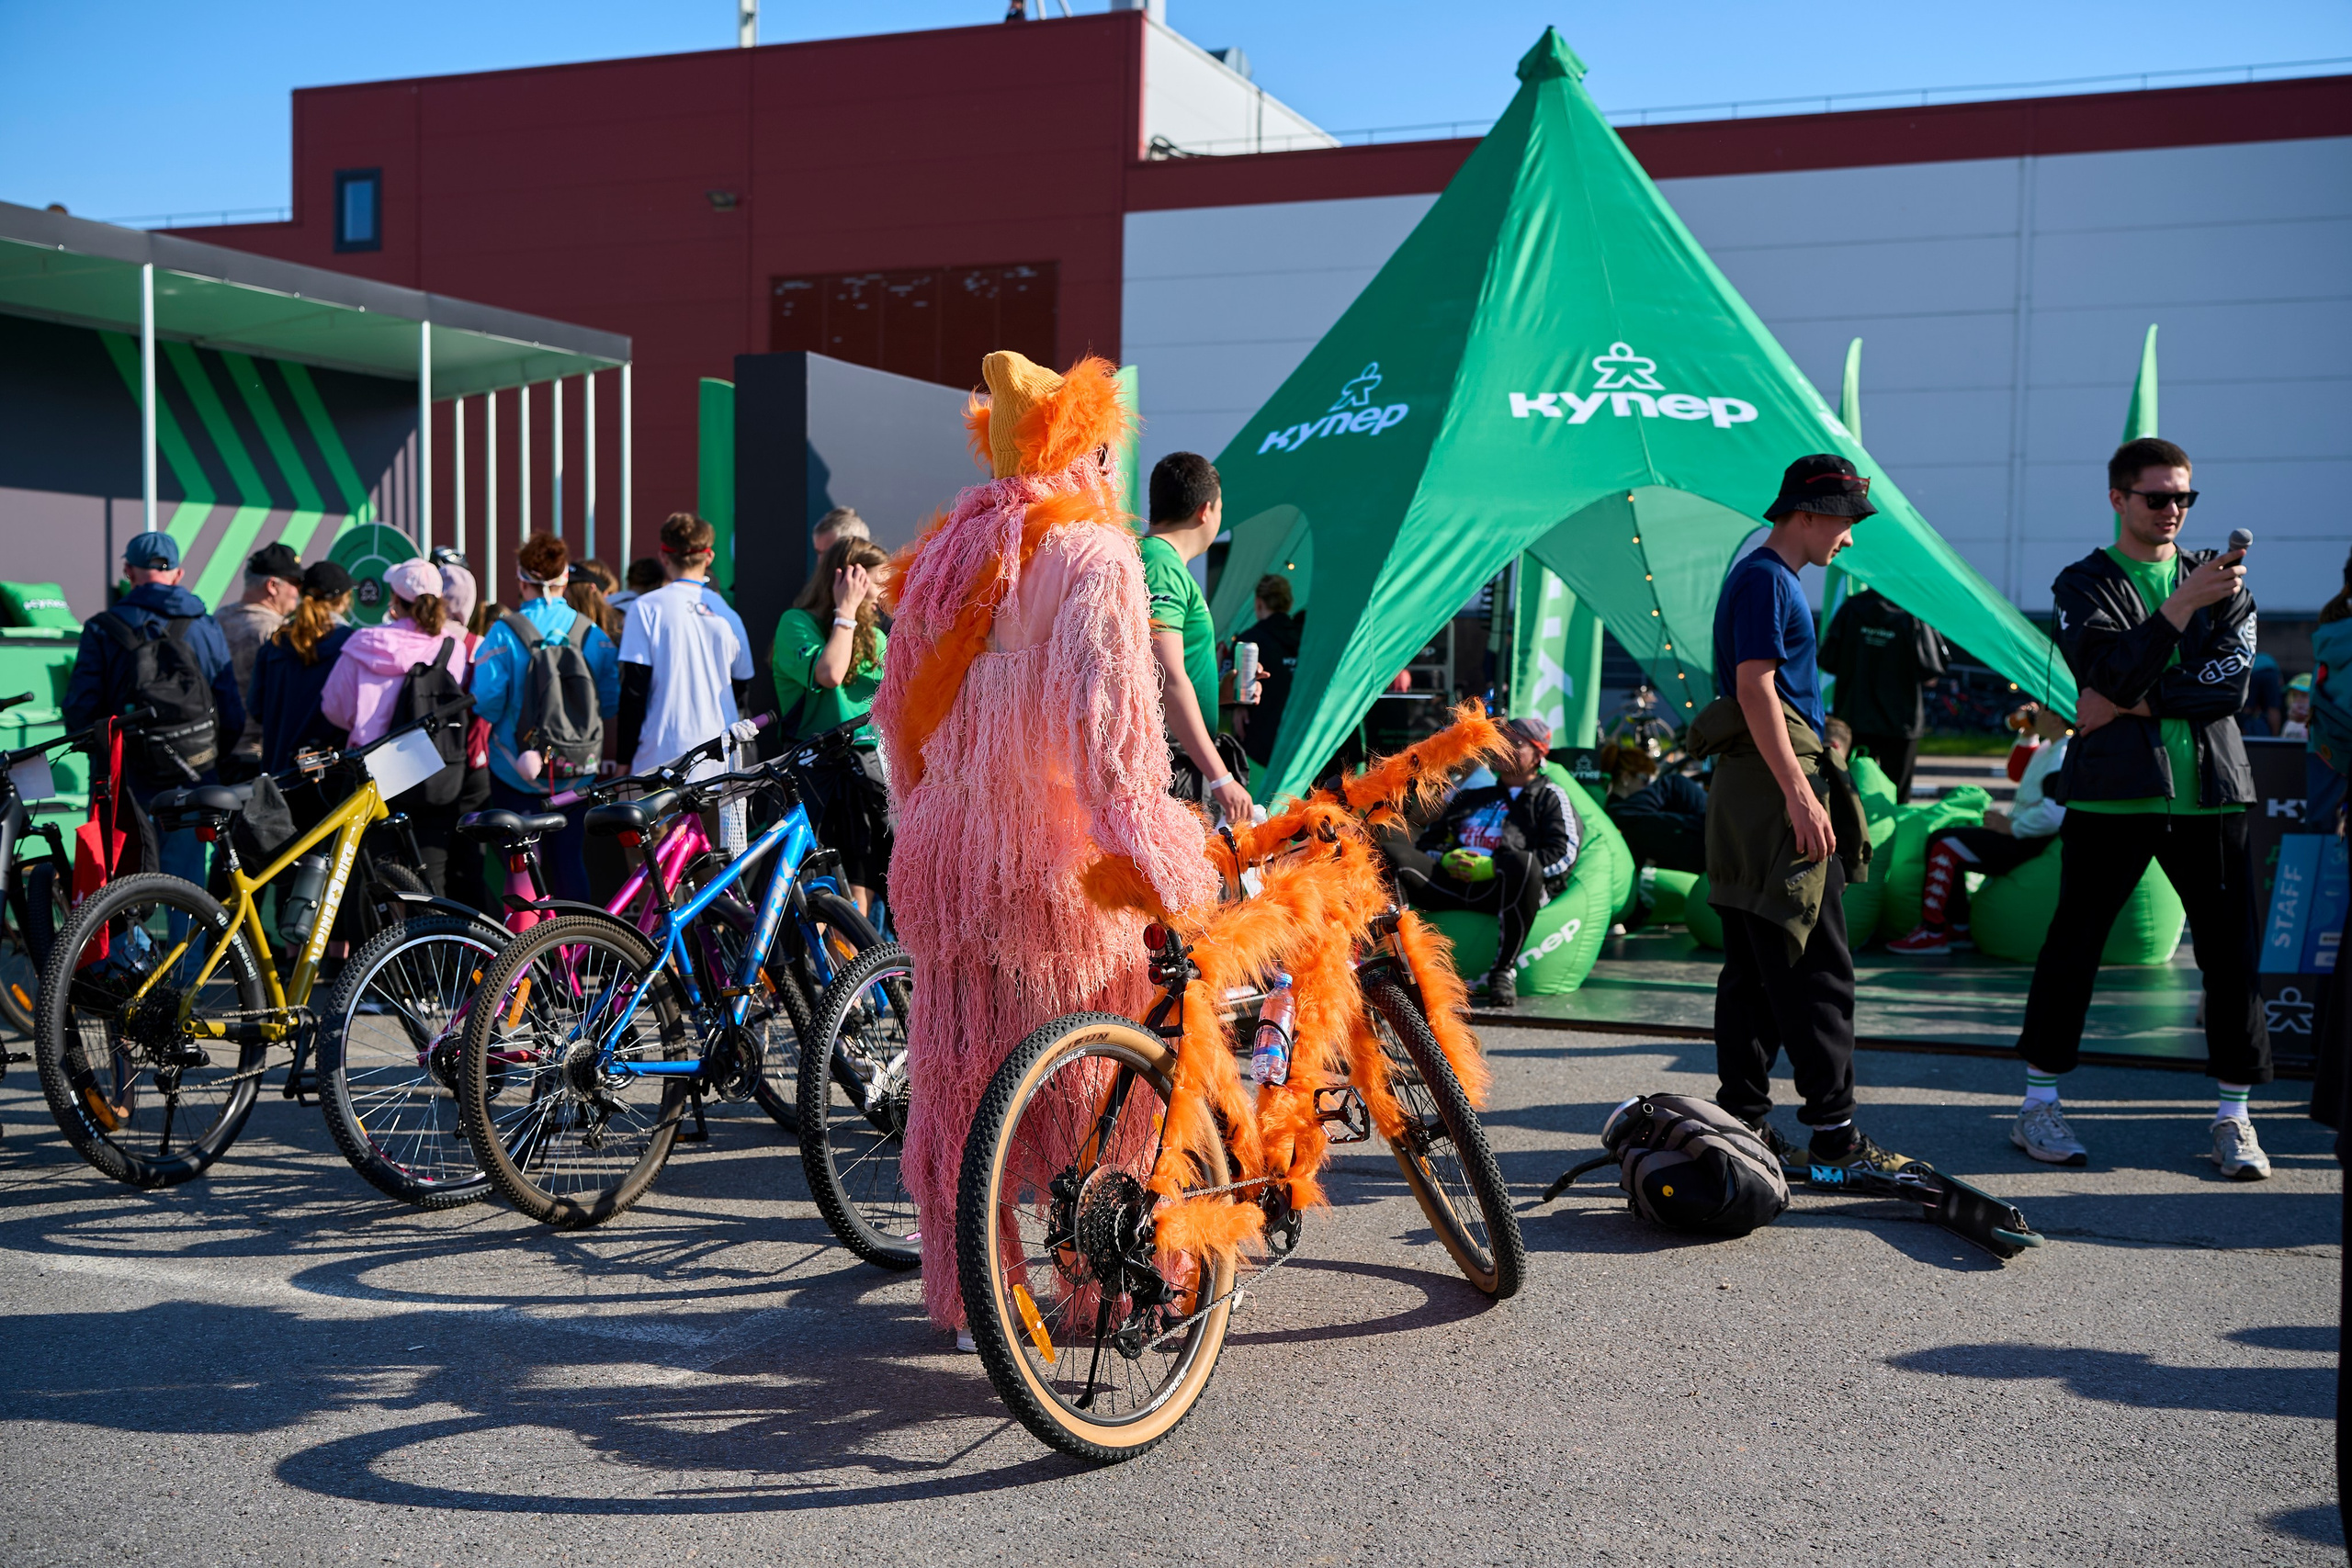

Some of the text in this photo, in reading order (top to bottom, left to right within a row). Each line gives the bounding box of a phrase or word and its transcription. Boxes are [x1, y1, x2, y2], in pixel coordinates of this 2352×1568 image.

[1256, 403, 1409, 455] купер
[1509, 391, 1758, 428] купер
[309, 840, 357, 965] ALPINE BIKE
[2273, 864, 2302, 948] STAFF
[1150, 1367, 1187, 1412] SOURCE
